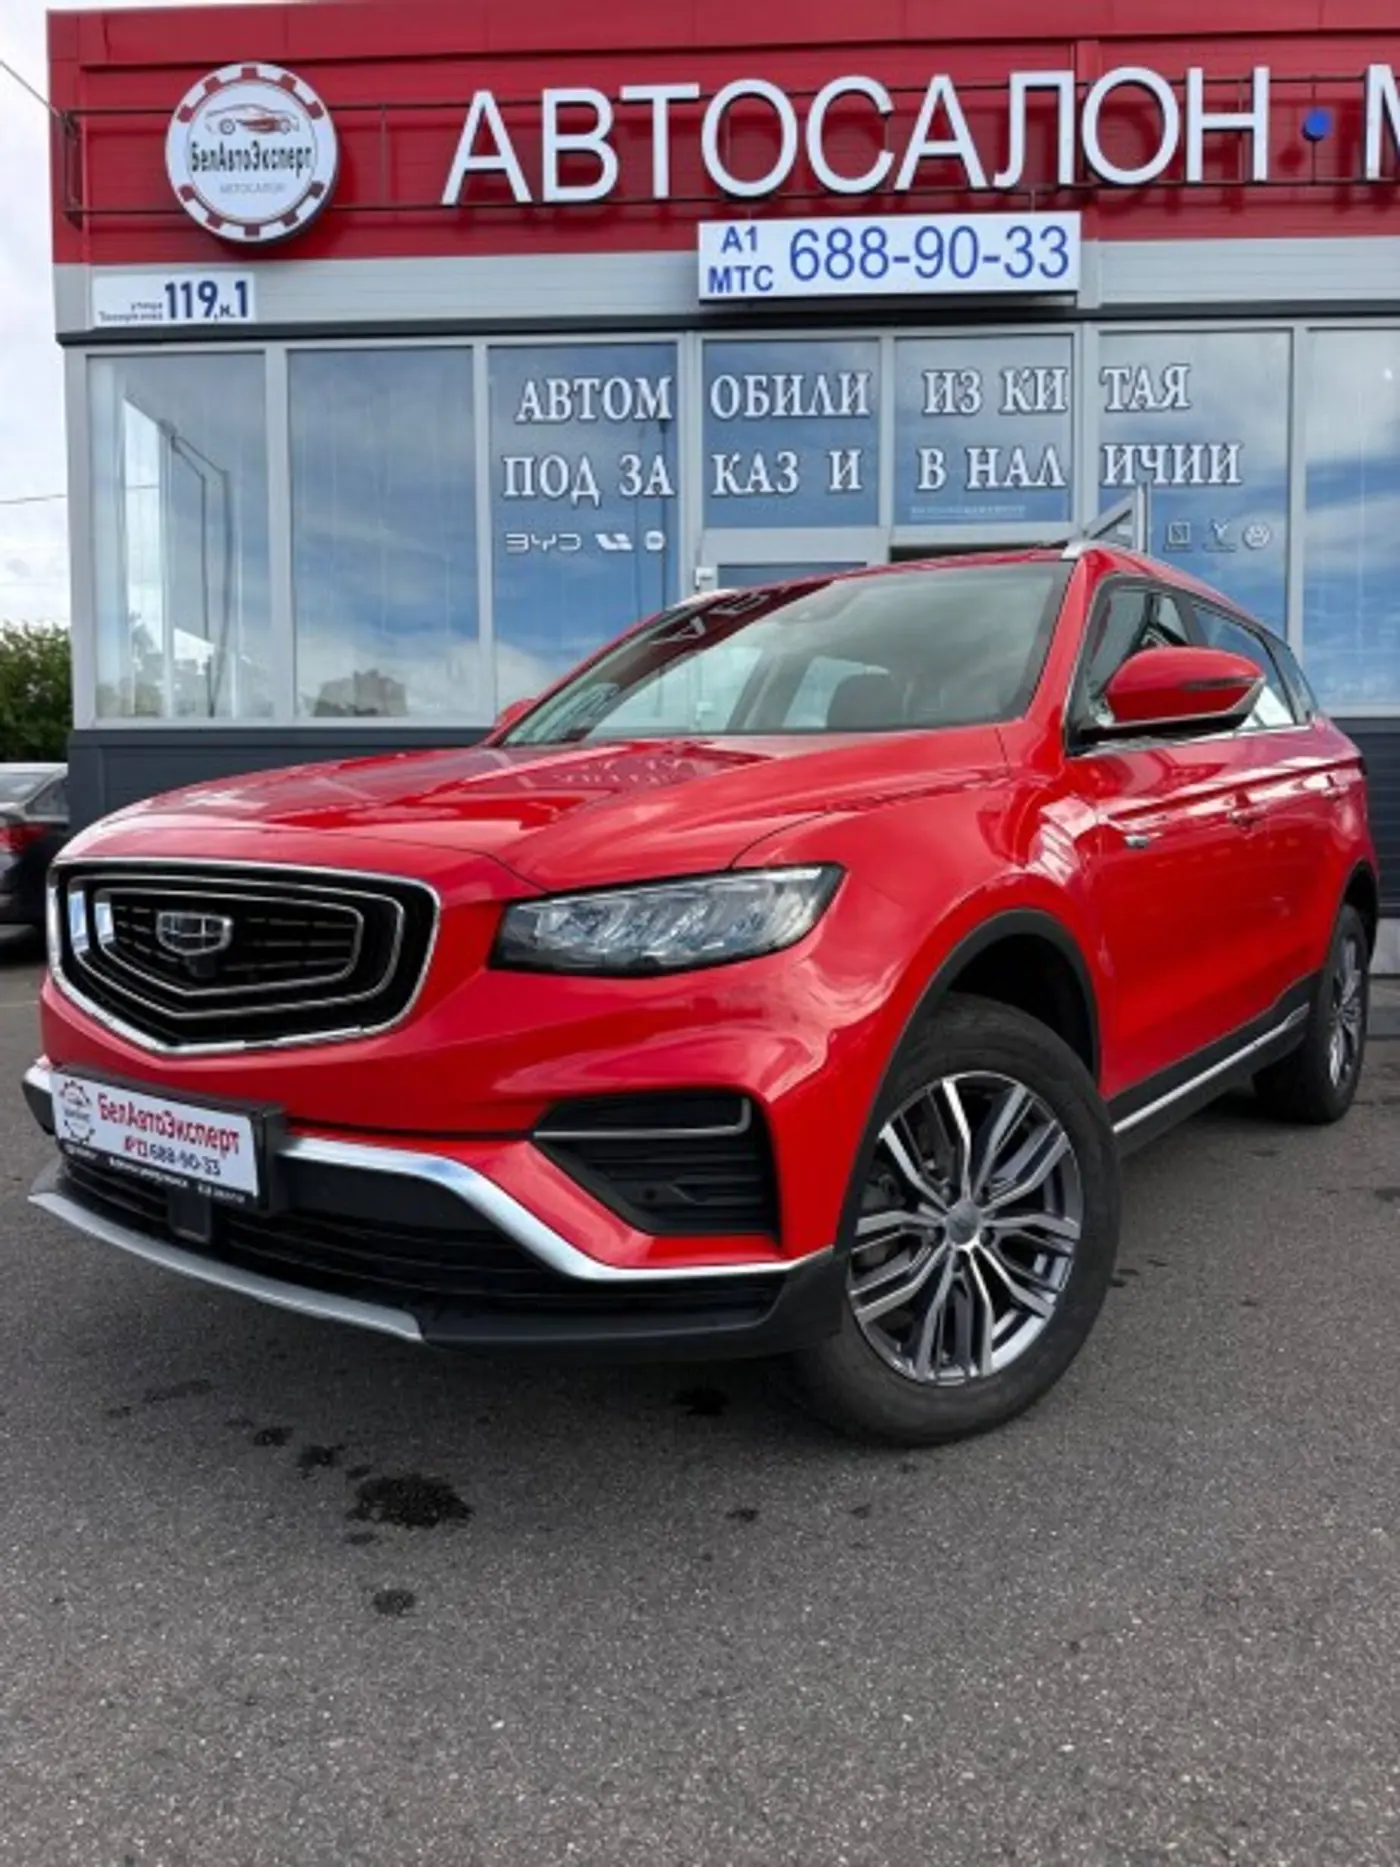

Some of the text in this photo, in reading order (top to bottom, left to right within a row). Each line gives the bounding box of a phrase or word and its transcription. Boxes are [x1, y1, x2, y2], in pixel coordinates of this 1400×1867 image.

[190, 140, 312, 178] БелАвтоЭксперт
[440, 65, 1270, 206] АВТОСАЛОН
[707, 265, 774, 294] МТС
[789, 223, 1071, 283] 688-90-33
[923, 369, 983, 415] ИЗ
[503, 454, 601, 507] ПОД
[829, 448, 862, 491] И
[917, 447, 946, 490] В
[506, 532, 583, 553] BYD
[97, 1092, 240, 1159] БелАвтоЭксперт
